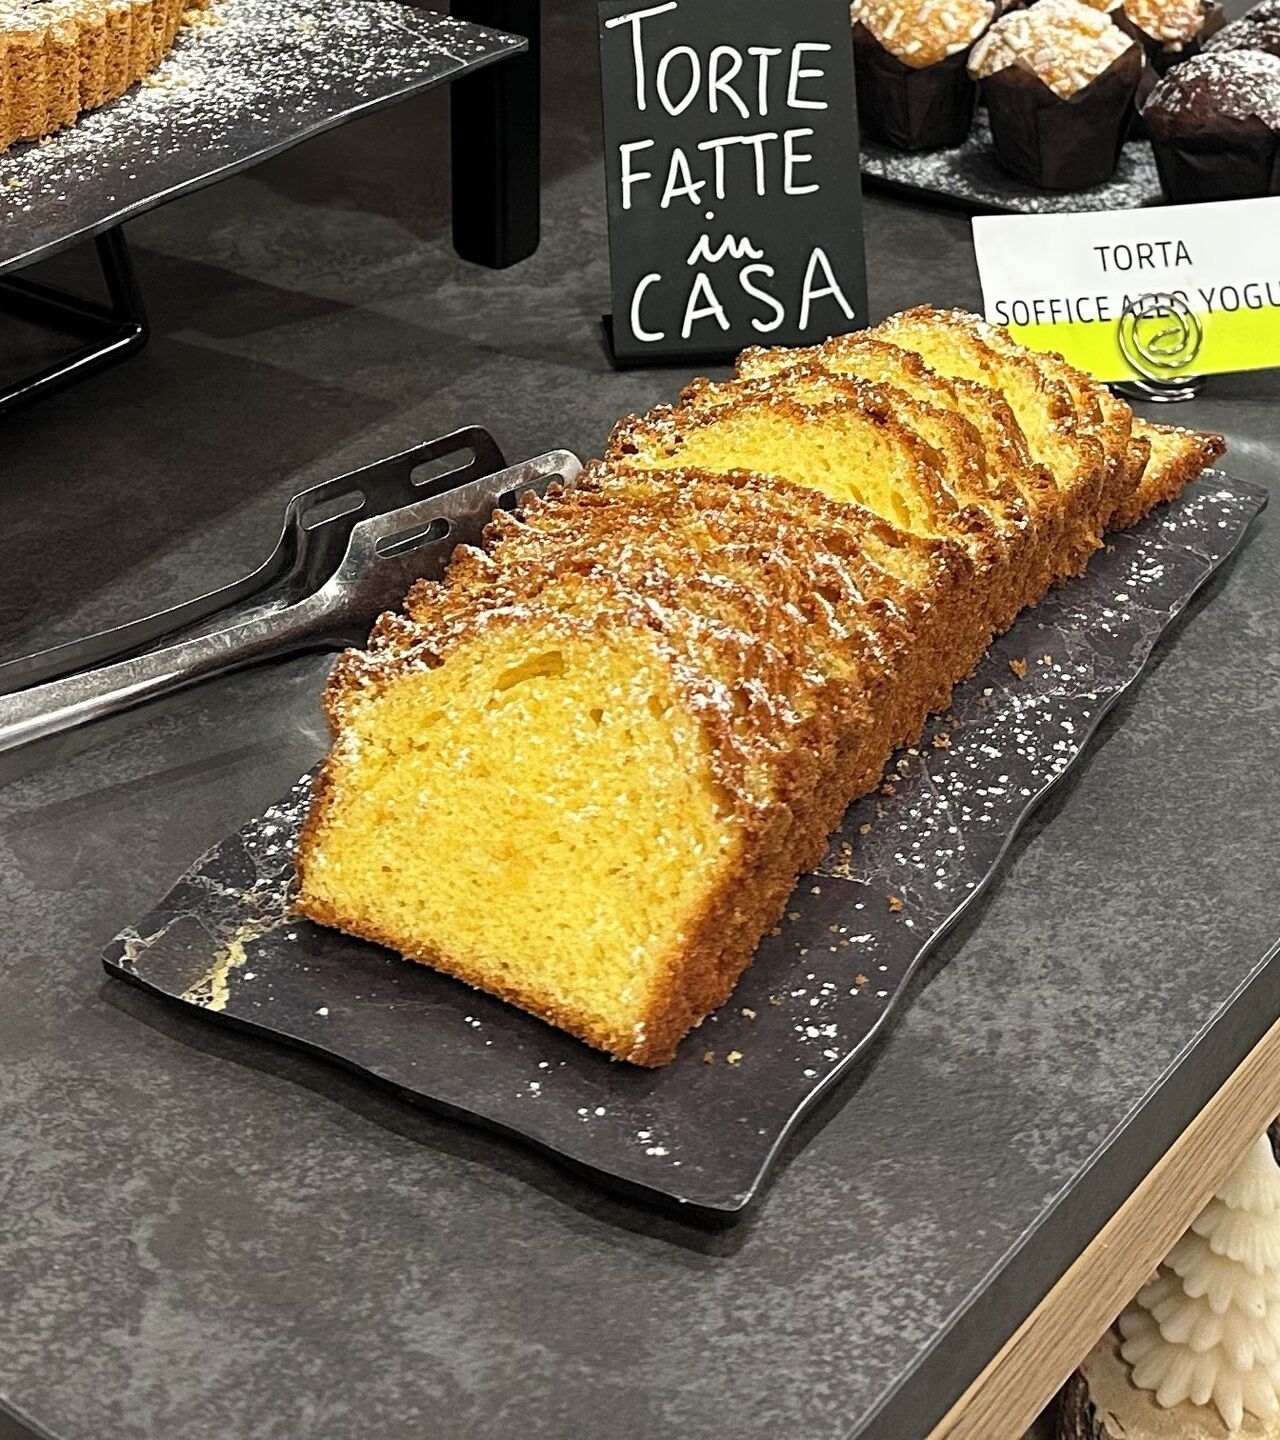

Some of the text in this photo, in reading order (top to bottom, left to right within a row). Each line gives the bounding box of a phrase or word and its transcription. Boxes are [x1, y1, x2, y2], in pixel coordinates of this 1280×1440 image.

[605, 1, 831, 119] TORTE
[619, 128, 820, 210] FATTE
[687, 211, 764, 265] in
[1093, 240, 1193, 272] TORTA
[630, 247, 855, 342] CASA
[995, 296, 1112, 326] SOFFICE
